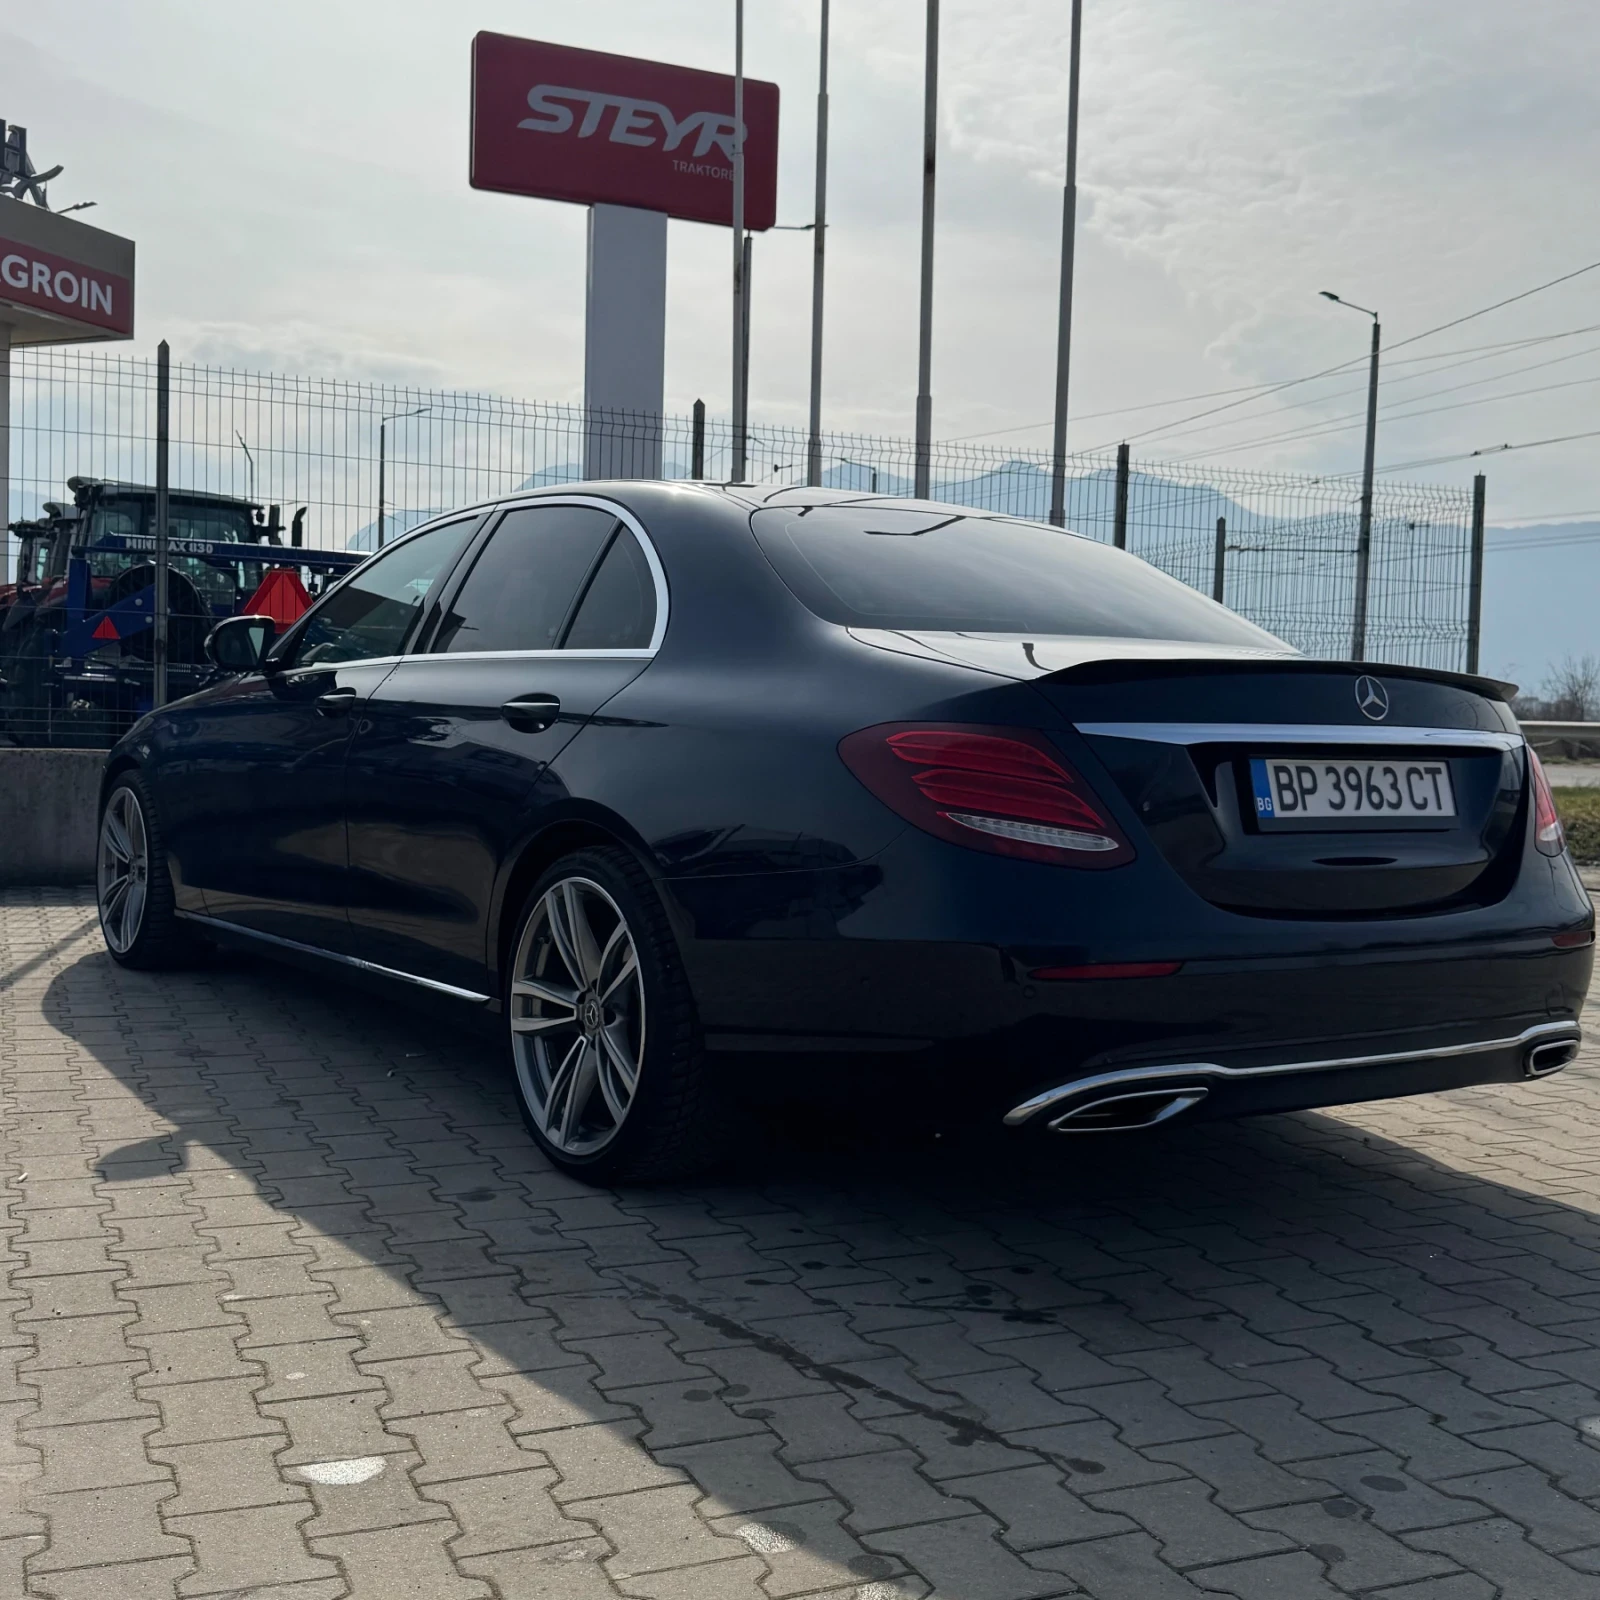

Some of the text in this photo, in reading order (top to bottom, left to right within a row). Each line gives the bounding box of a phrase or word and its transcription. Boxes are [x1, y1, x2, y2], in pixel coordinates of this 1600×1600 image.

[517, 84, 748, 162] STEYR
[0, 254, 112, 315] GROIN
[125, 537, 186, 552] MINIAX
[1258, 797, 1272, 811] BG
[1273, 765, 1443, 811] BP 3963 CT
